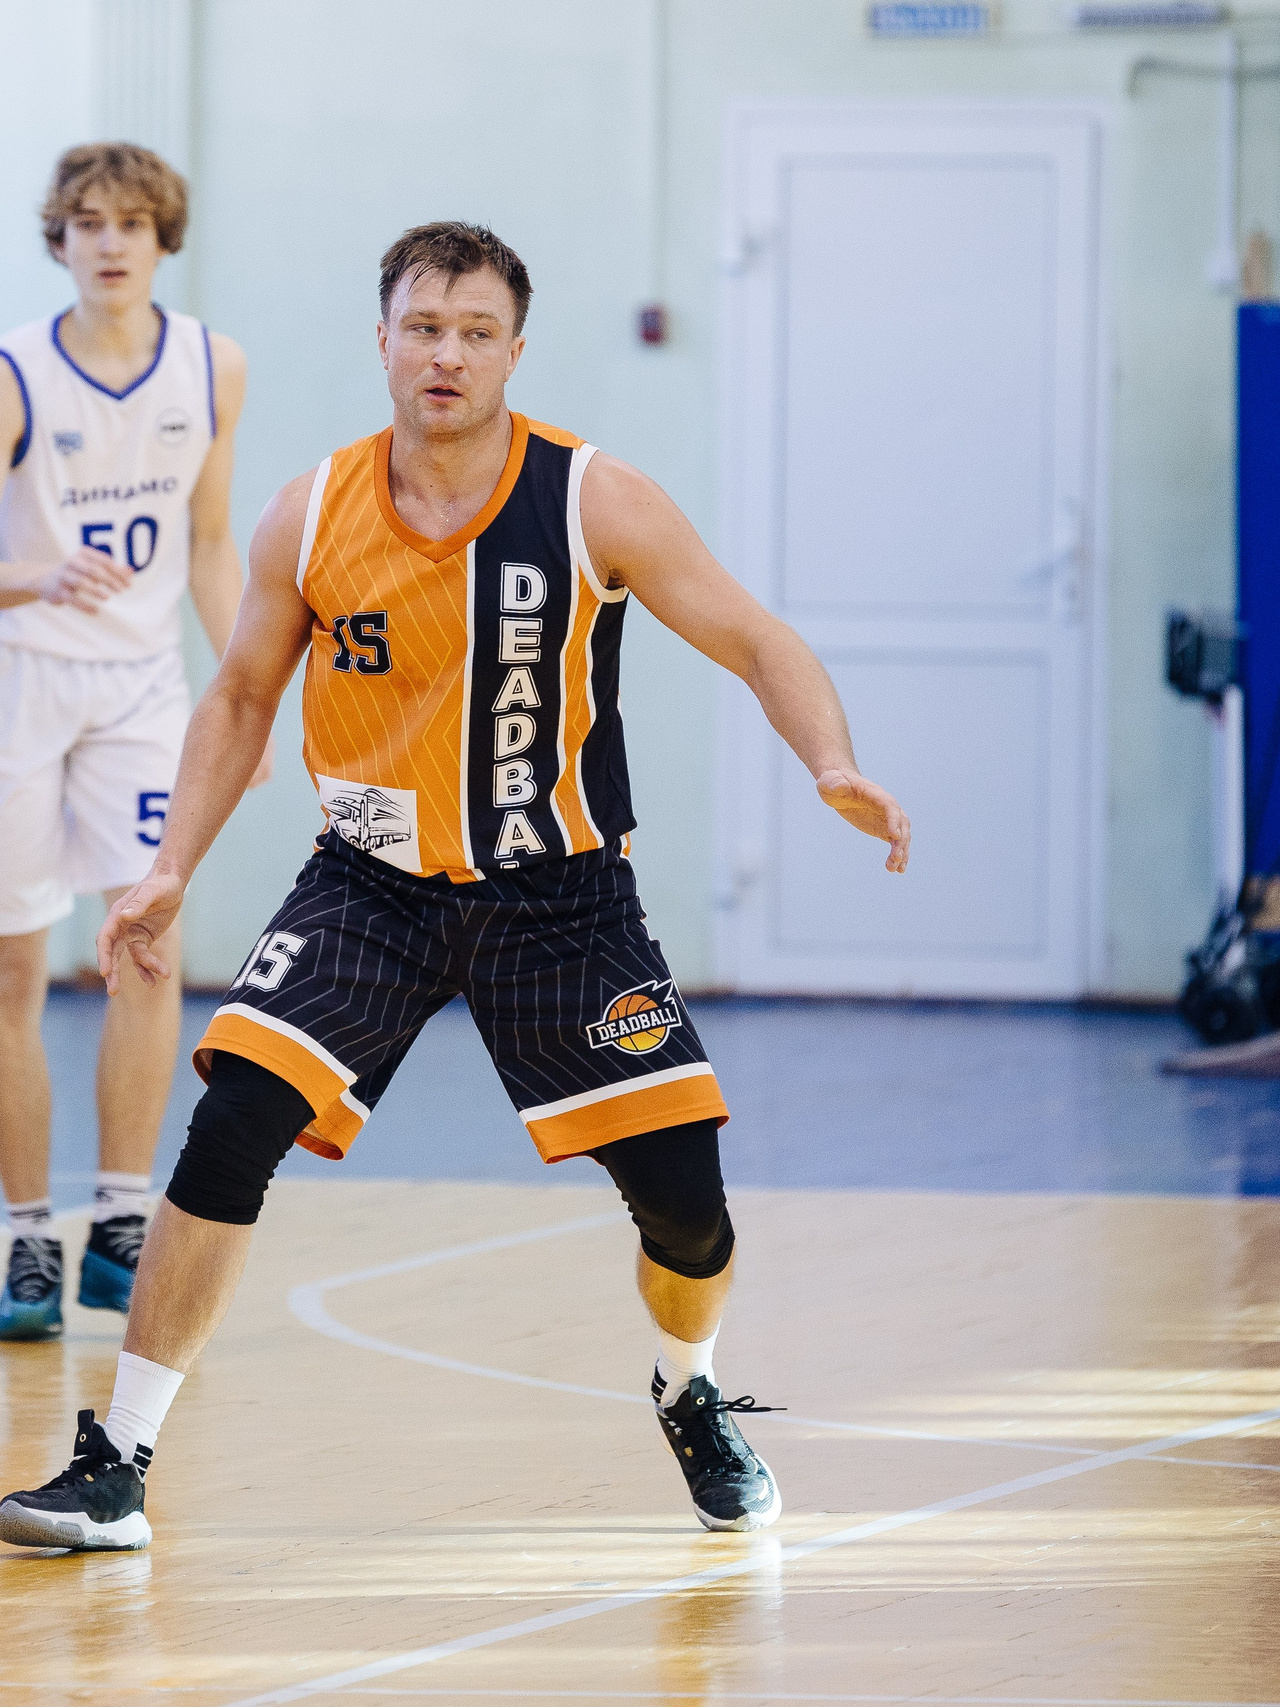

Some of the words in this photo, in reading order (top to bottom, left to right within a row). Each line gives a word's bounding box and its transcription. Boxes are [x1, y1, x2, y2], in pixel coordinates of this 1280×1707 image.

[81, 515, 158, 572] 50
[331, 610, 393, 675] 15
[492, 562, 548, 869] DEADBA
[230, 930, 308, 992] 15
[596, 1008, 677, 1042] DEADBALL
